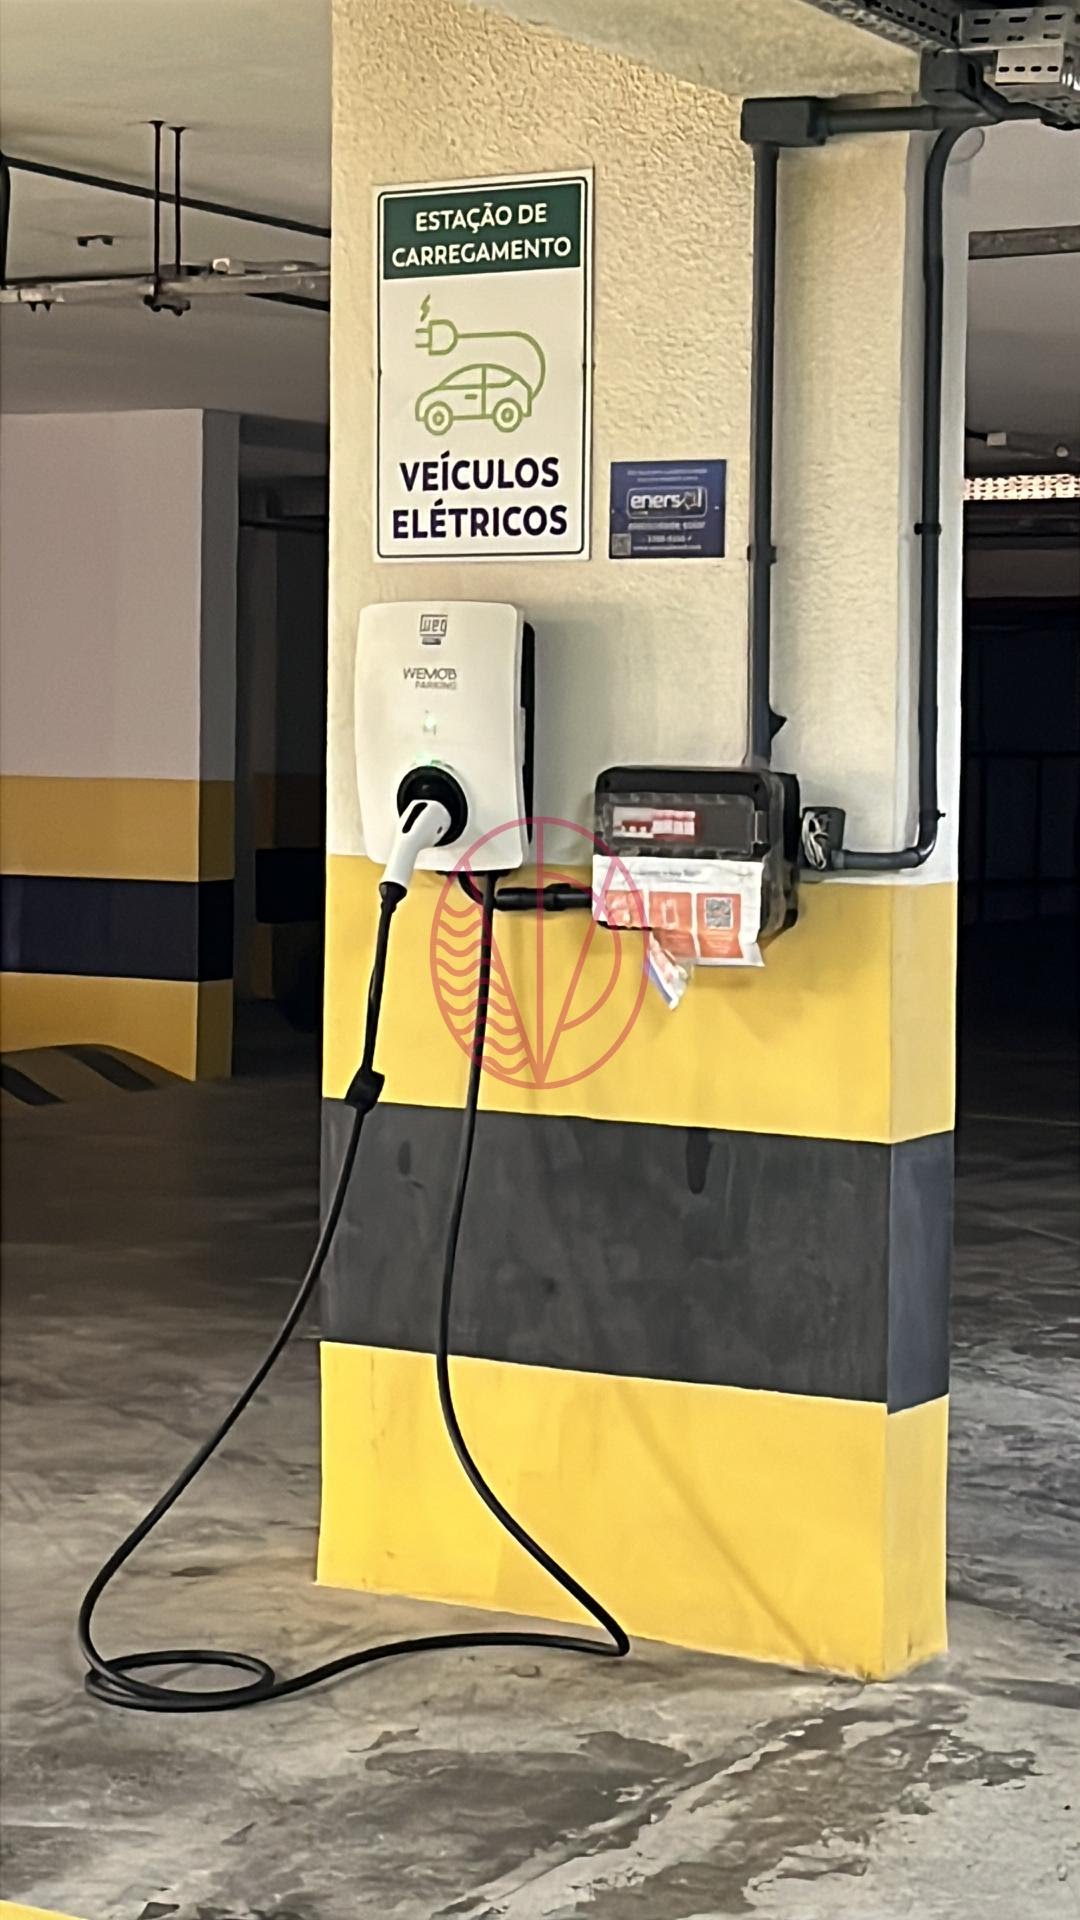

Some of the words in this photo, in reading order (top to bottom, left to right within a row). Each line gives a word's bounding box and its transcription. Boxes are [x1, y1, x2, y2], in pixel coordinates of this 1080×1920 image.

[415, 202, 512, 234] ESTAÇÃO
[518, 203, 547, 224] DE
[391, 236, 572, 268] CARREGAMENTO
[399, 450, 560, 492] VEÍCULOS
[392, 498, 568, 539] ELÉTRICOS
[403, 666, 457, 680] WEMOB
